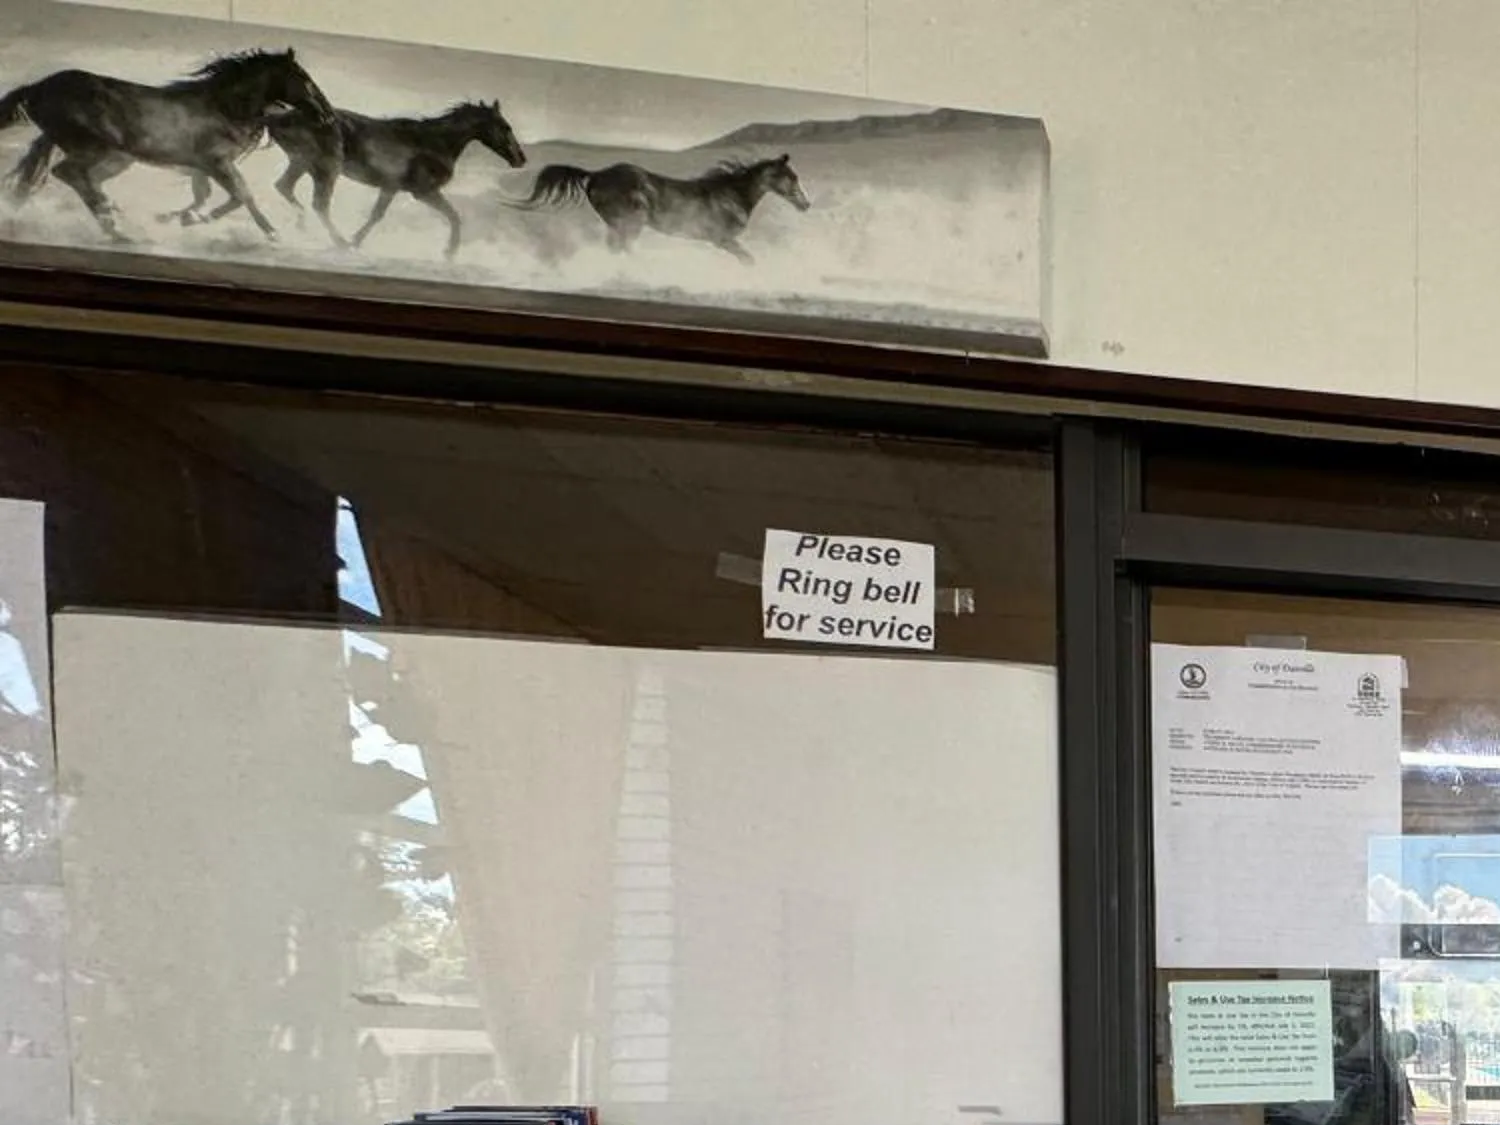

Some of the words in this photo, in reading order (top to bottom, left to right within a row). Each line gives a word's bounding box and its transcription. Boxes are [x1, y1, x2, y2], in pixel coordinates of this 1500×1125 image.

[795, 535, 902, 567] Please
[778, 567, 853, 605] Ring
[863, 578, 921, 605] bell
[765, 605, 811, 632] for
[819, 615, 933, 643] service
